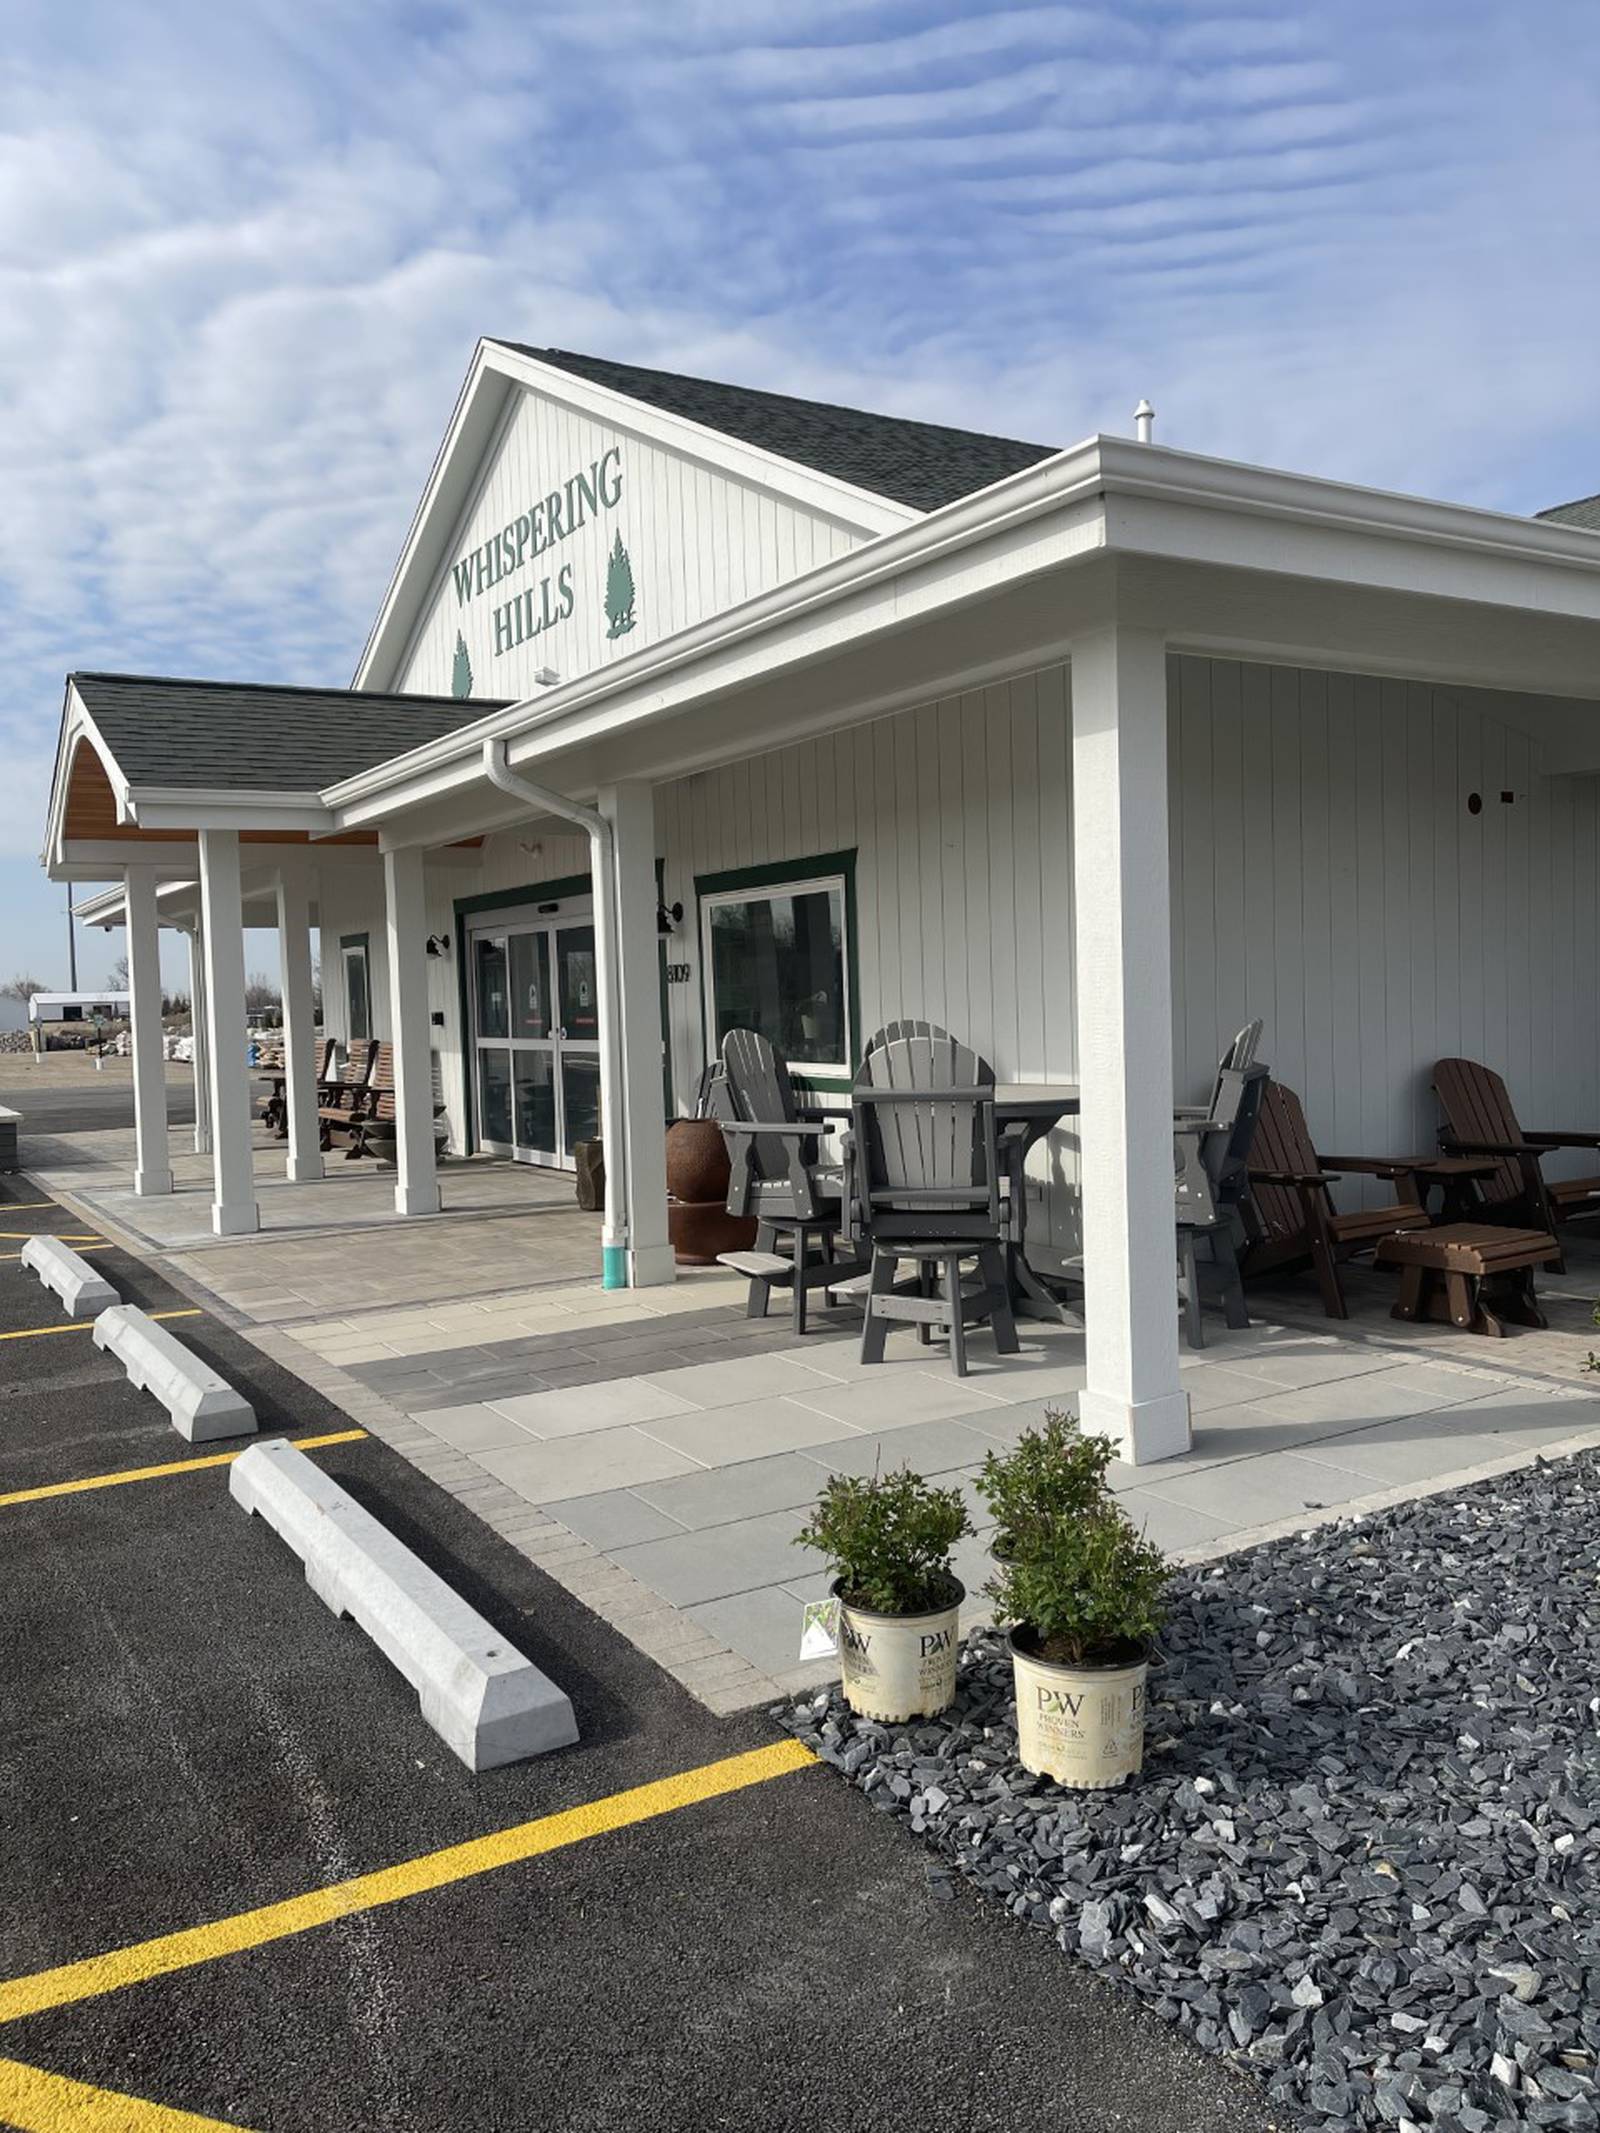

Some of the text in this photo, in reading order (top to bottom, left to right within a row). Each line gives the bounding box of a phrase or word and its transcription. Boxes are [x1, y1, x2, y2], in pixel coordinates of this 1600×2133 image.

[452, 446, 622, 609] WHISPERING
[493, 563, 574, 657] HILLS
[1036, 1685, 1086, 1717] PW
[1037, 1721, 1086, 1739] WINNERS
[1039, 1712, 1080, 1728] PROVEN
